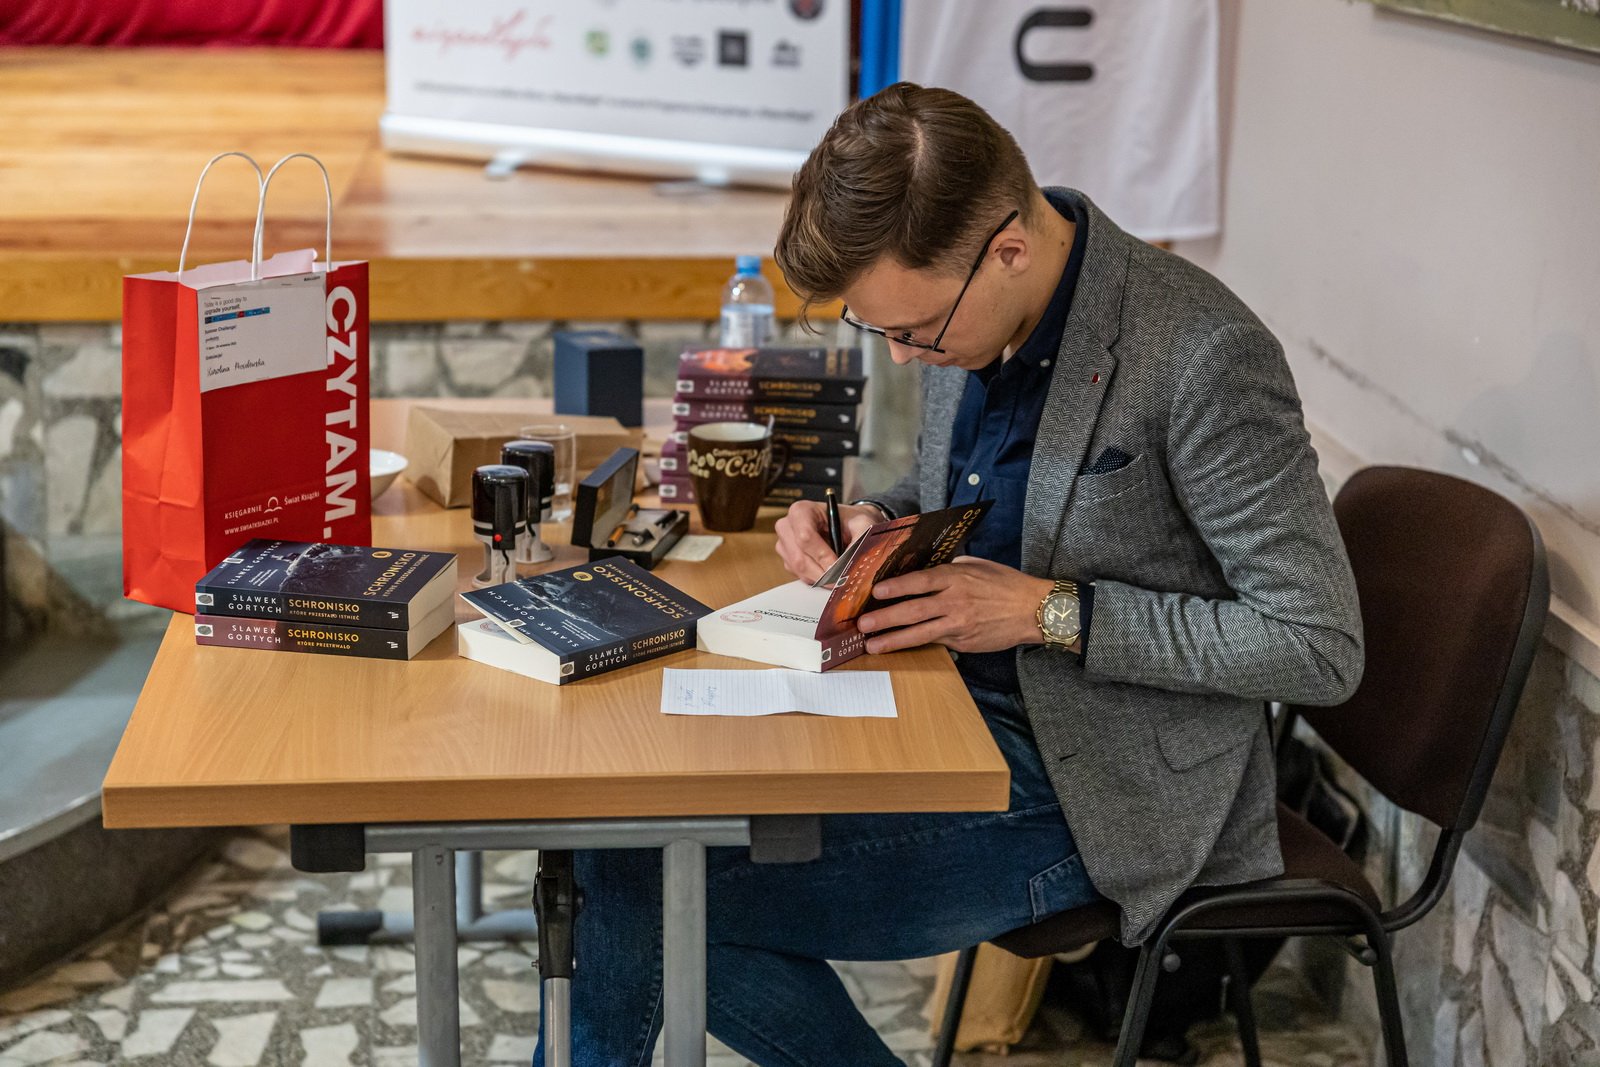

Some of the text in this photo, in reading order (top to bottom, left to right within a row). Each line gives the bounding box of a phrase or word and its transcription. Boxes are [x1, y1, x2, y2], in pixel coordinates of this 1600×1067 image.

[363, 552, 417, 596] SCHRONISKO
[592, 566, 685, 619] SCHRONISKO
[228, 602, 282, 614] GORTYCH
[288, 598, 360, 613] SCHRONISKO
[487, 590, 535, 621] GORTYCH
[227, 633, 281, 644] GORTYCH
[287, 629, 360, 642] SCHRONISKO
[632, 628, 685, 651] SCHRONISKO
[585, 654, 627, 672] GORTYCH
